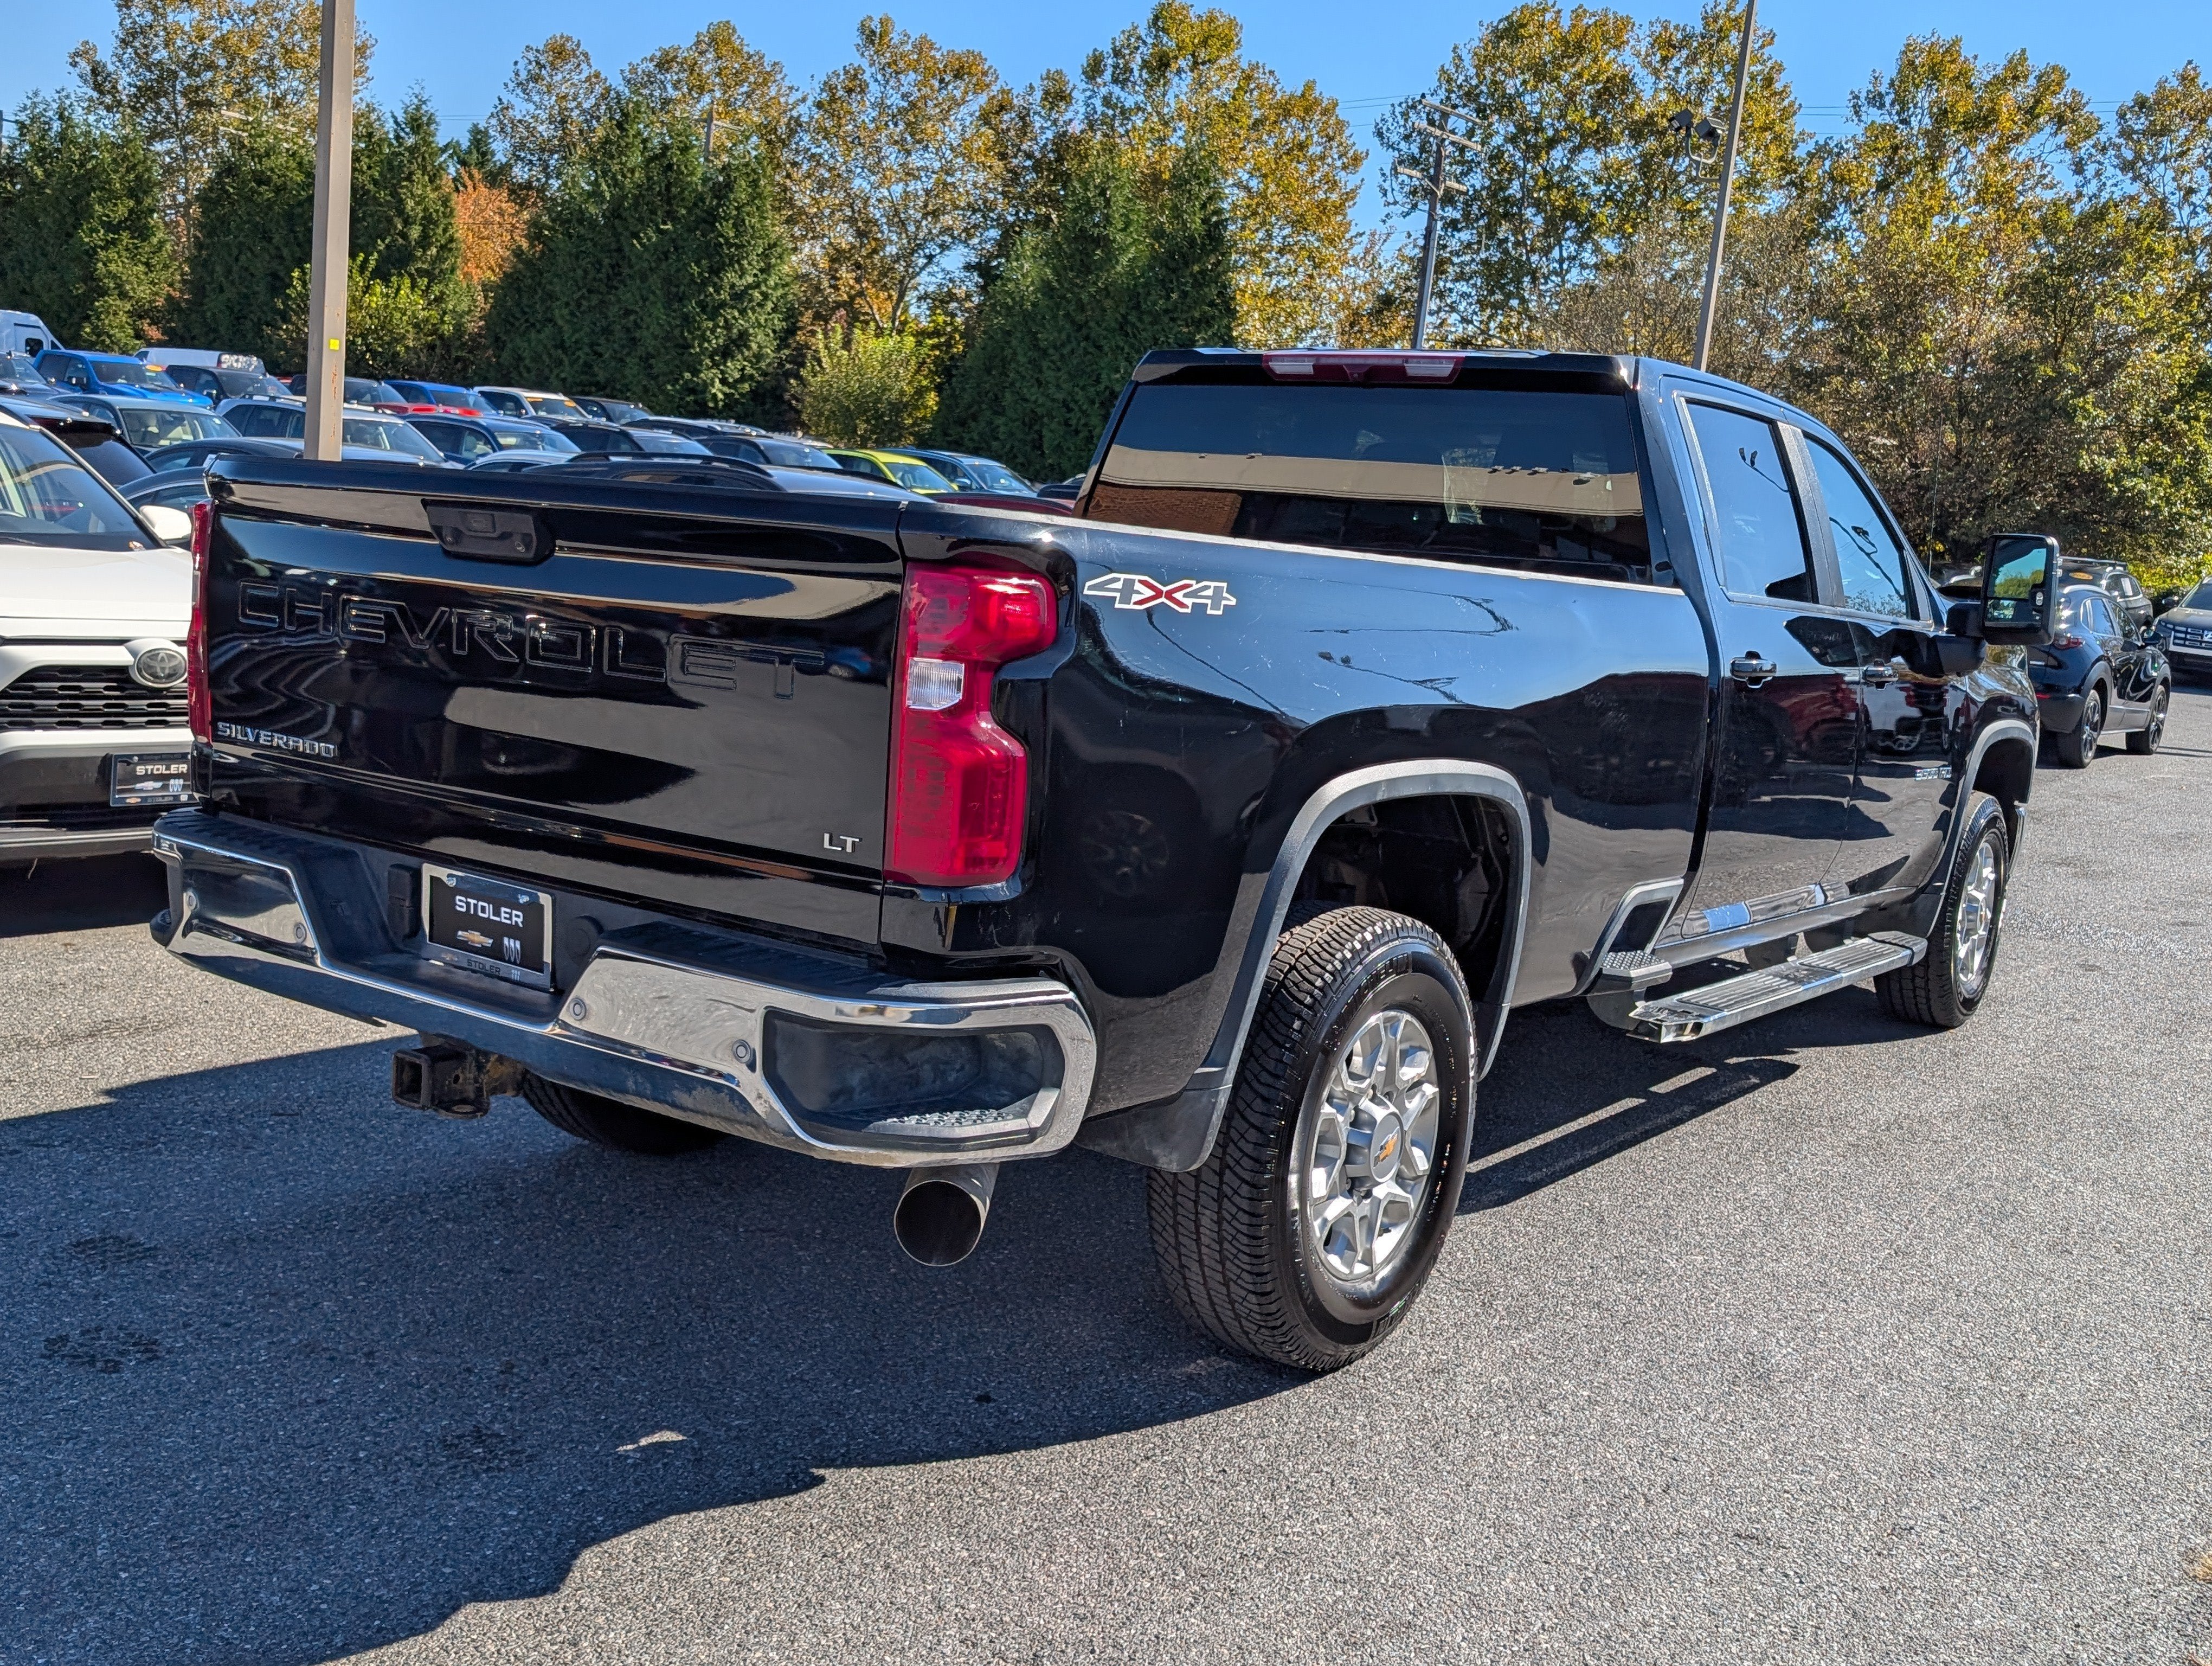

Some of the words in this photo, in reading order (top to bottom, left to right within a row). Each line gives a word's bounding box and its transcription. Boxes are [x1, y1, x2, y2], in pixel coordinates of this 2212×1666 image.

[239, 581, 825, 700] CHEVROLET
[217, 721, 338, 758] SILVERADO
[136, 764, 188, 776] STOLER
[824, 832, 862, 853] LT
[454, 895, 523, 928] STOLER
[466, 958, 501, 976] STOLER
